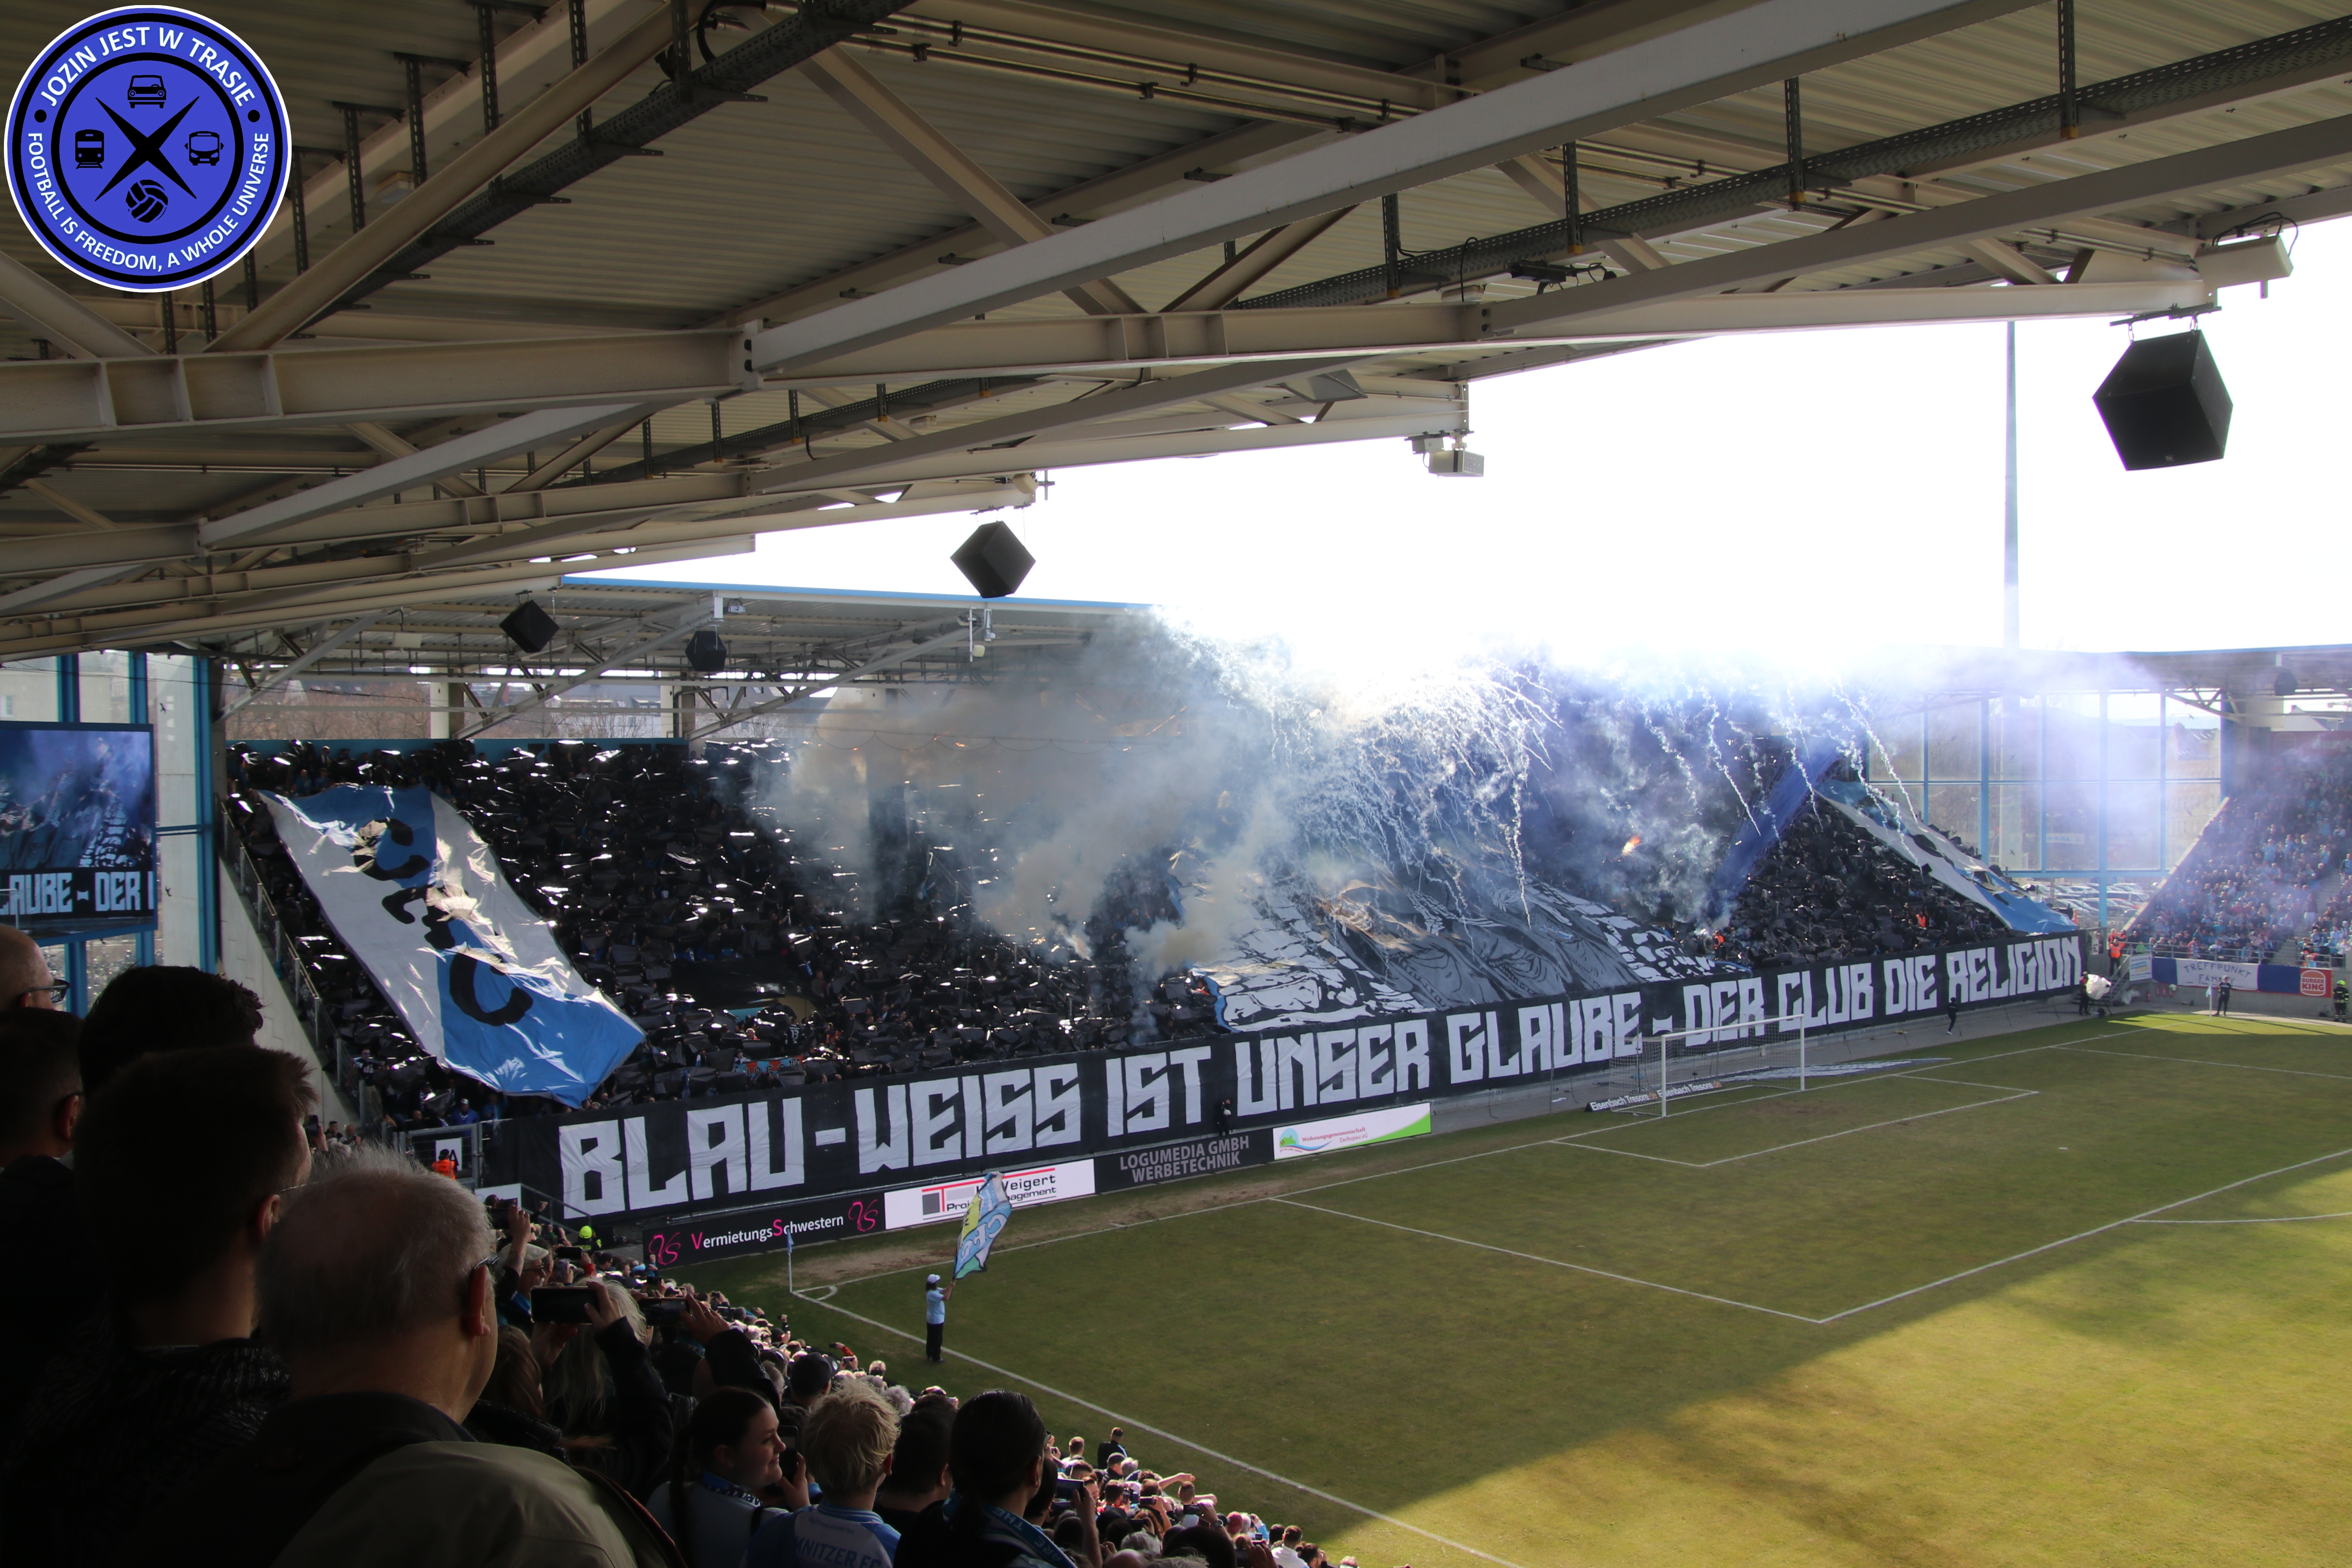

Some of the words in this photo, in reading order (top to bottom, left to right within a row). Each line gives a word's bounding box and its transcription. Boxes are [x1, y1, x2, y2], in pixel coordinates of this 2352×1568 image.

[95, 871, 141, 911] DER
[2183, 962, 2251, 978] TREFFPUNKT
[2199, 974, 2234, 984] FAMY
[1106, 1045, 1211, 1137] IST
[1235, 1019, 1430, 1116] UNSER
[1446, 991, 1642, 1084] GLAUBE
[1683, 977, 1764, 1047] DER
[1777, 963, 1873, 1033] CLUB
[1884, 955, 1937, 1015] DIE
[1946, 936, 2082, 1003] RELIGION
[1657, 1085, 1690, 1098] Esenbach
[1590, 1097, 1626, 1111] Eisenbach
[1302, 1126, 1366, 1142] Wohnungsgenossenschaft
[1120, 1143, 1205, 1170] LOGUMEDIA
[1208, 1136, 1249, 1154] GMBH
[1132, 1151, 1240, 1183] WERBETECHNIK
[992, 1507, 1024, 1531] THE
